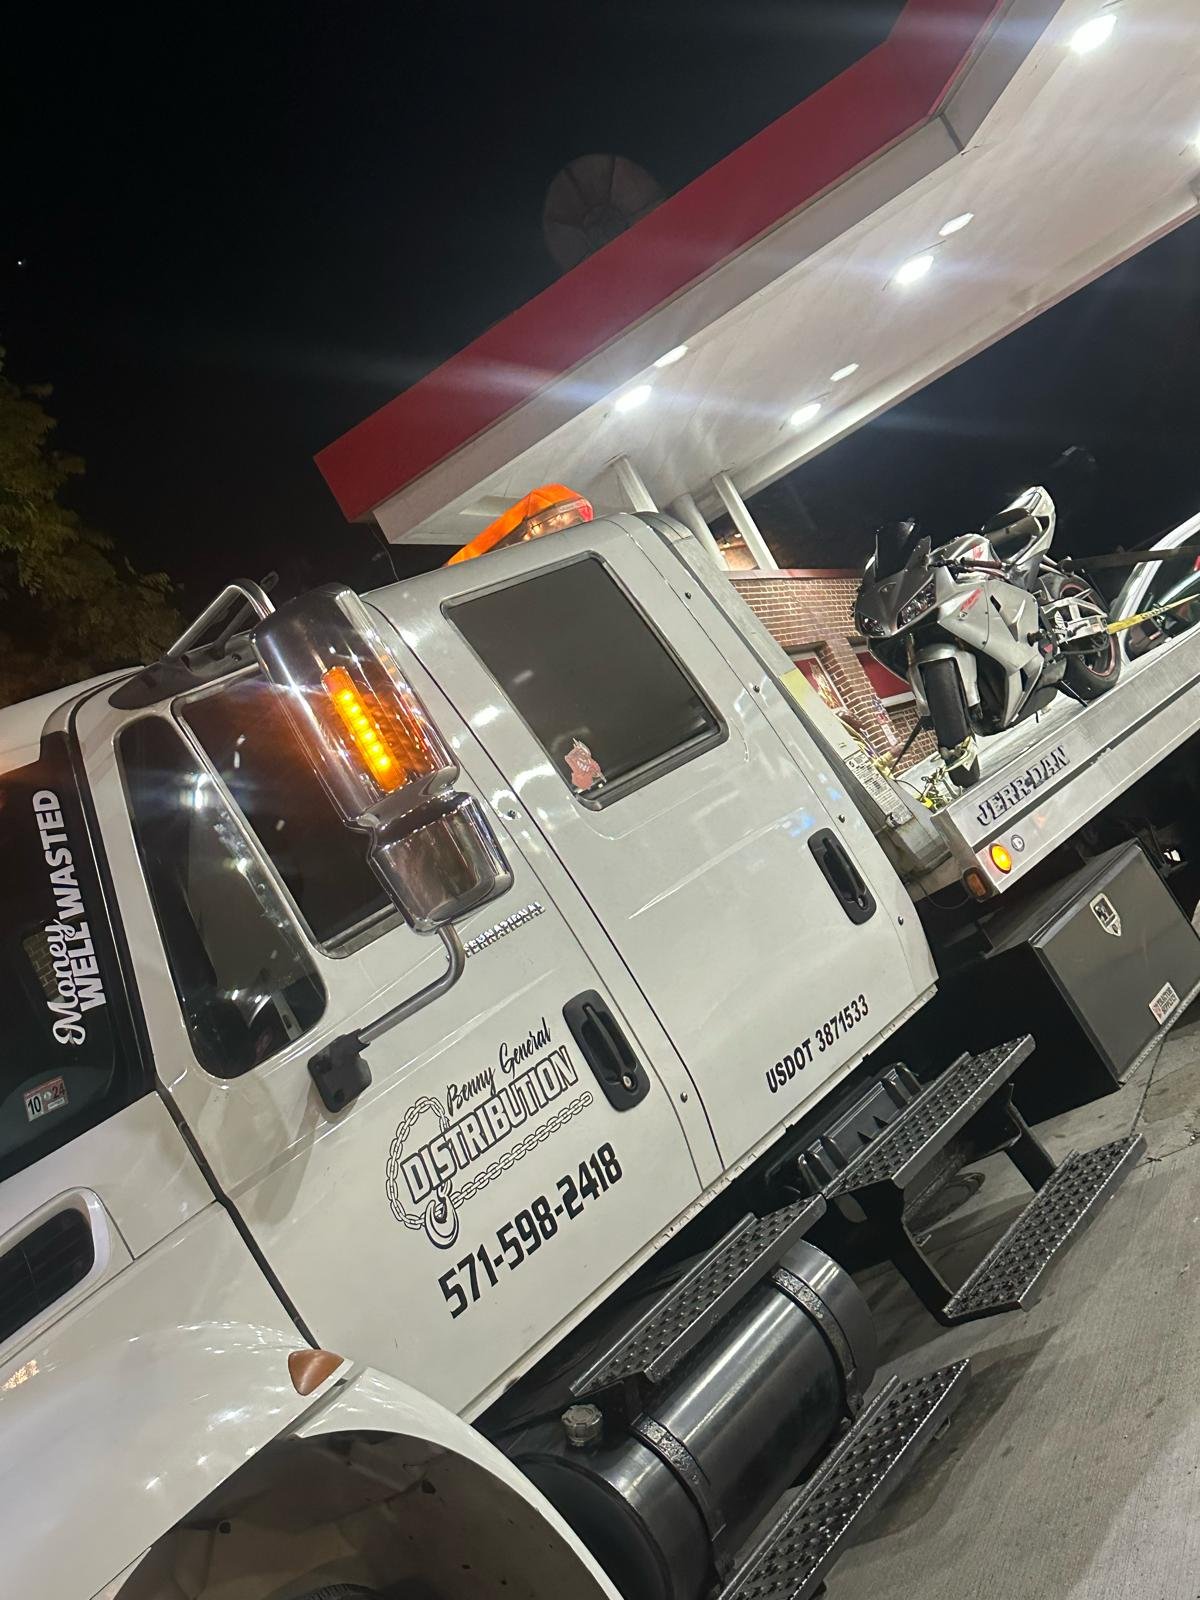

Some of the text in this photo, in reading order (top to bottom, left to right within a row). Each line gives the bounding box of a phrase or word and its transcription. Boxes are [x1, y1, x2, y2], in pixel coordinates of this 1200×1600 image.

[33, 789, 107, 1011] WELL WASTED
[445, 901, 546, 961] ITERNATIONAL
[46, 918, 86, 1046] Money
[446, 1017, 551, 1116] Benny General
[765, 993, 869, 1094] USDOT 3871533
[27, 1095, 42, 1115] 10
[400, 1045, 579, 1205] DISTRIBUTION
[437, 1142, 623, 1319] 571-598-2418
